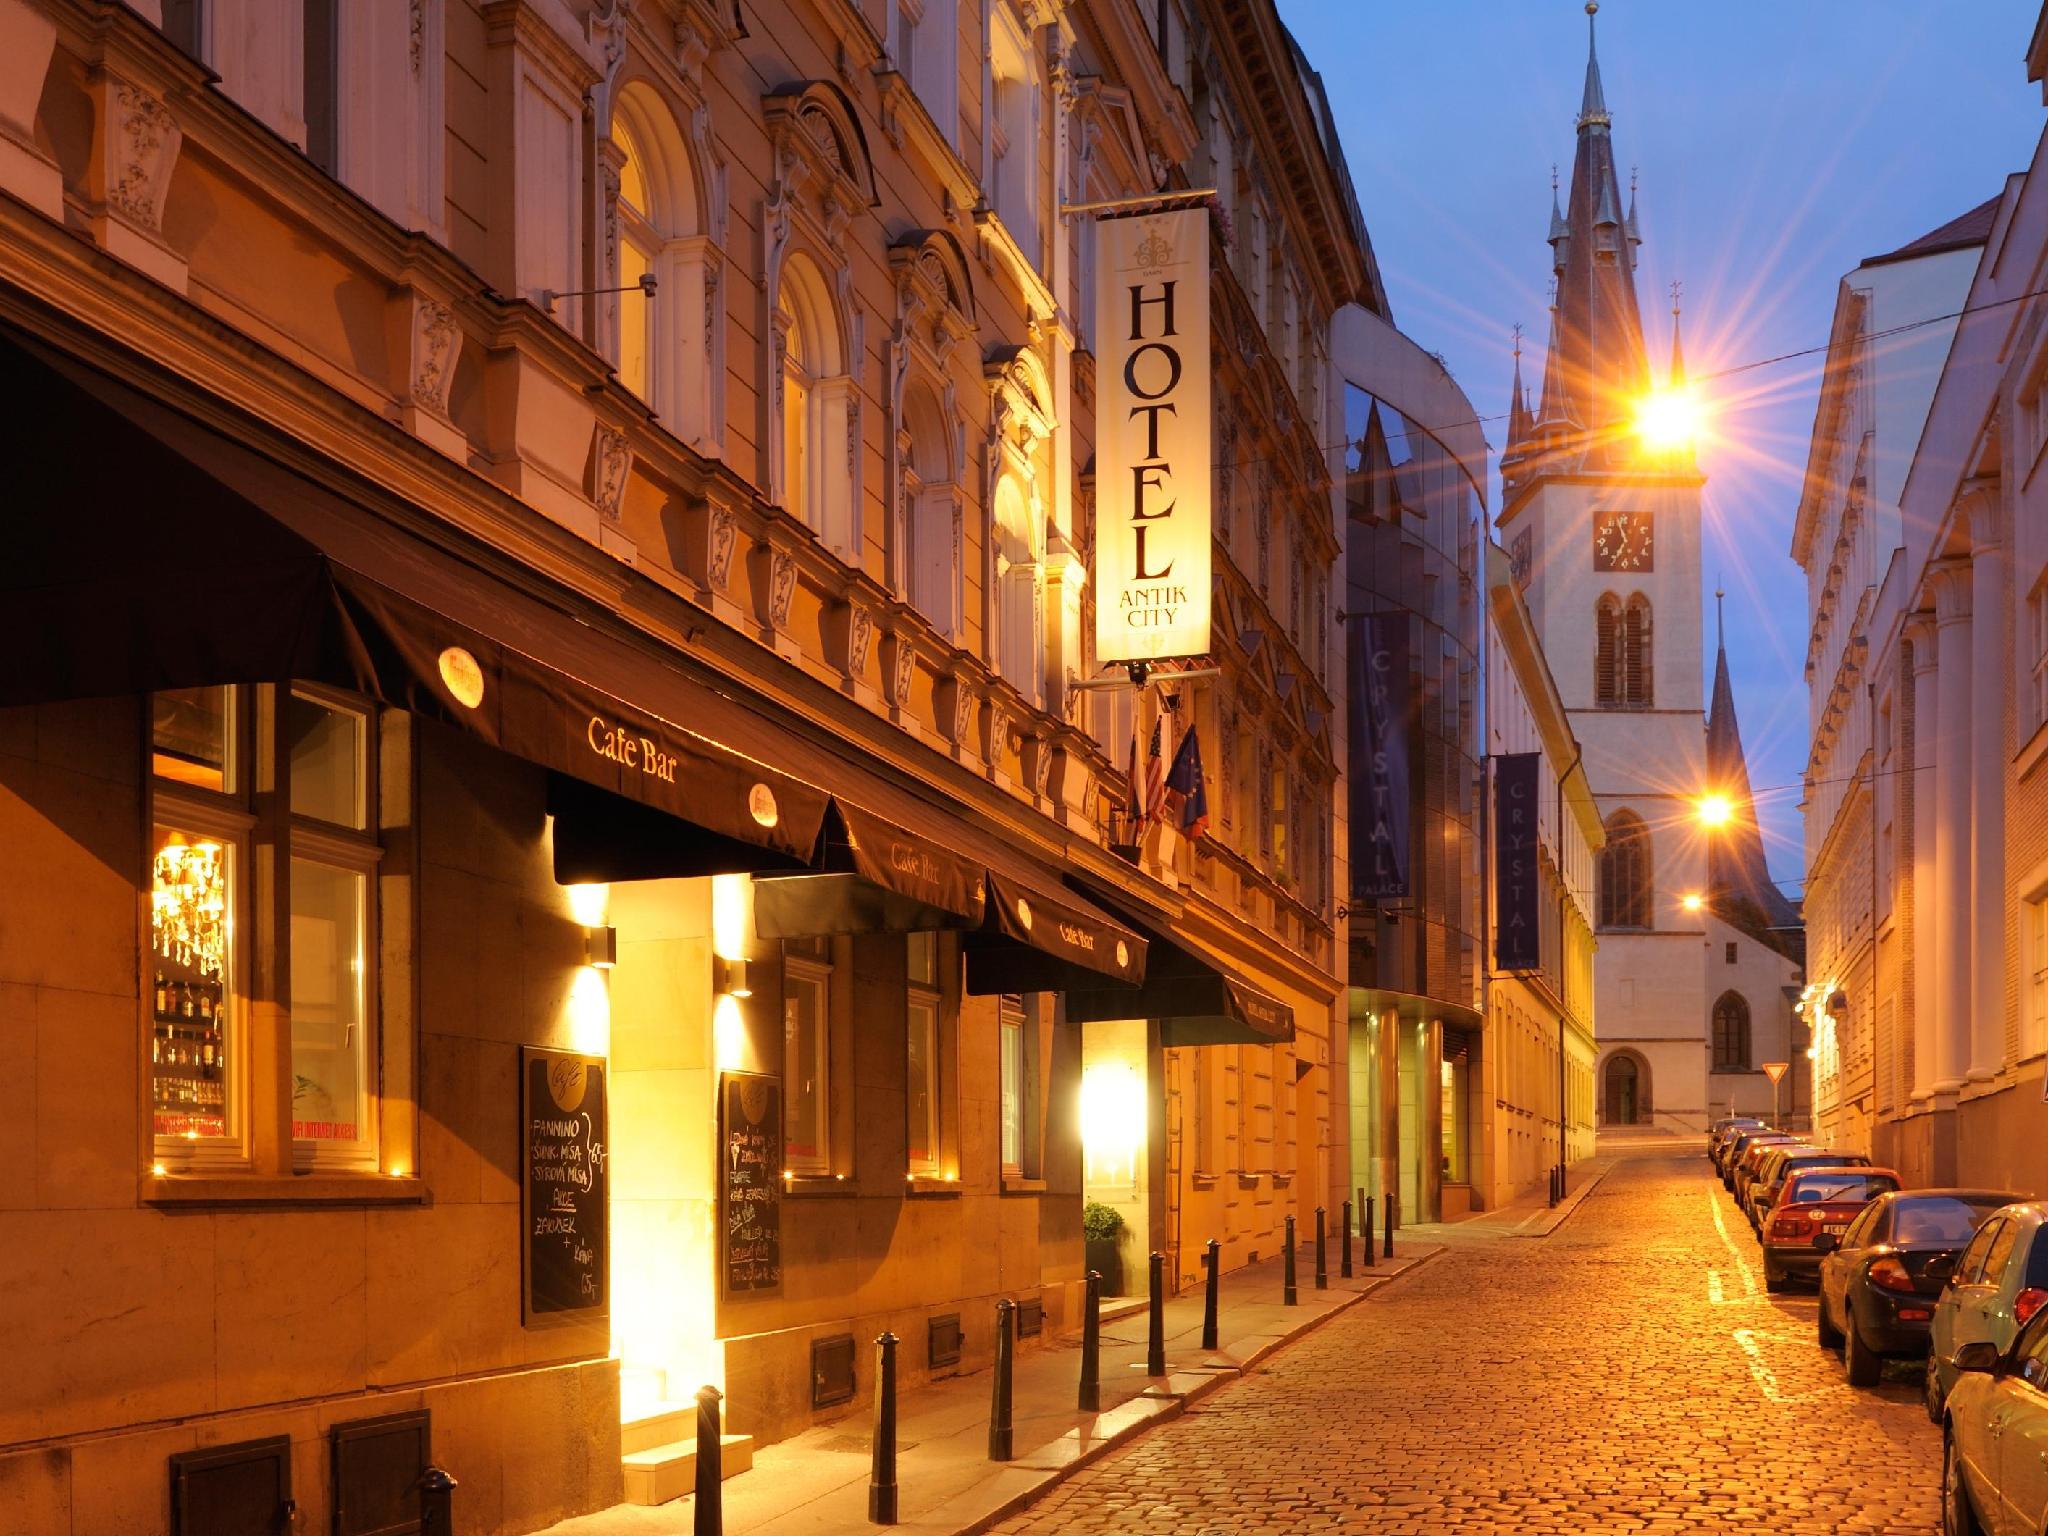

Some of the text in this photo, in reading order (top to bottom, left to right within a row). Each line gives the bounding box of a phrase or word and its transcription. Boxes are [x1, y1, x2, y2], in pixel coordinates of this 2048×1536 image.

[1124, 279, 1182, 580] HOTEL
[1120, 586, 1187, 608] ANTIK
[1128, 607, 1178, 627] CITY
[588, 716, 677, 784] Cafe Bar
[1371, 650, 1391, 877] CRYSTAL
[891, 842, 920, 877] Cafe
[1510, 781, 1525, 954] CRYSTAL
[1358, 882, 1404, 896] PALACE
[533, 1119, 580, 1137] PANNINO
